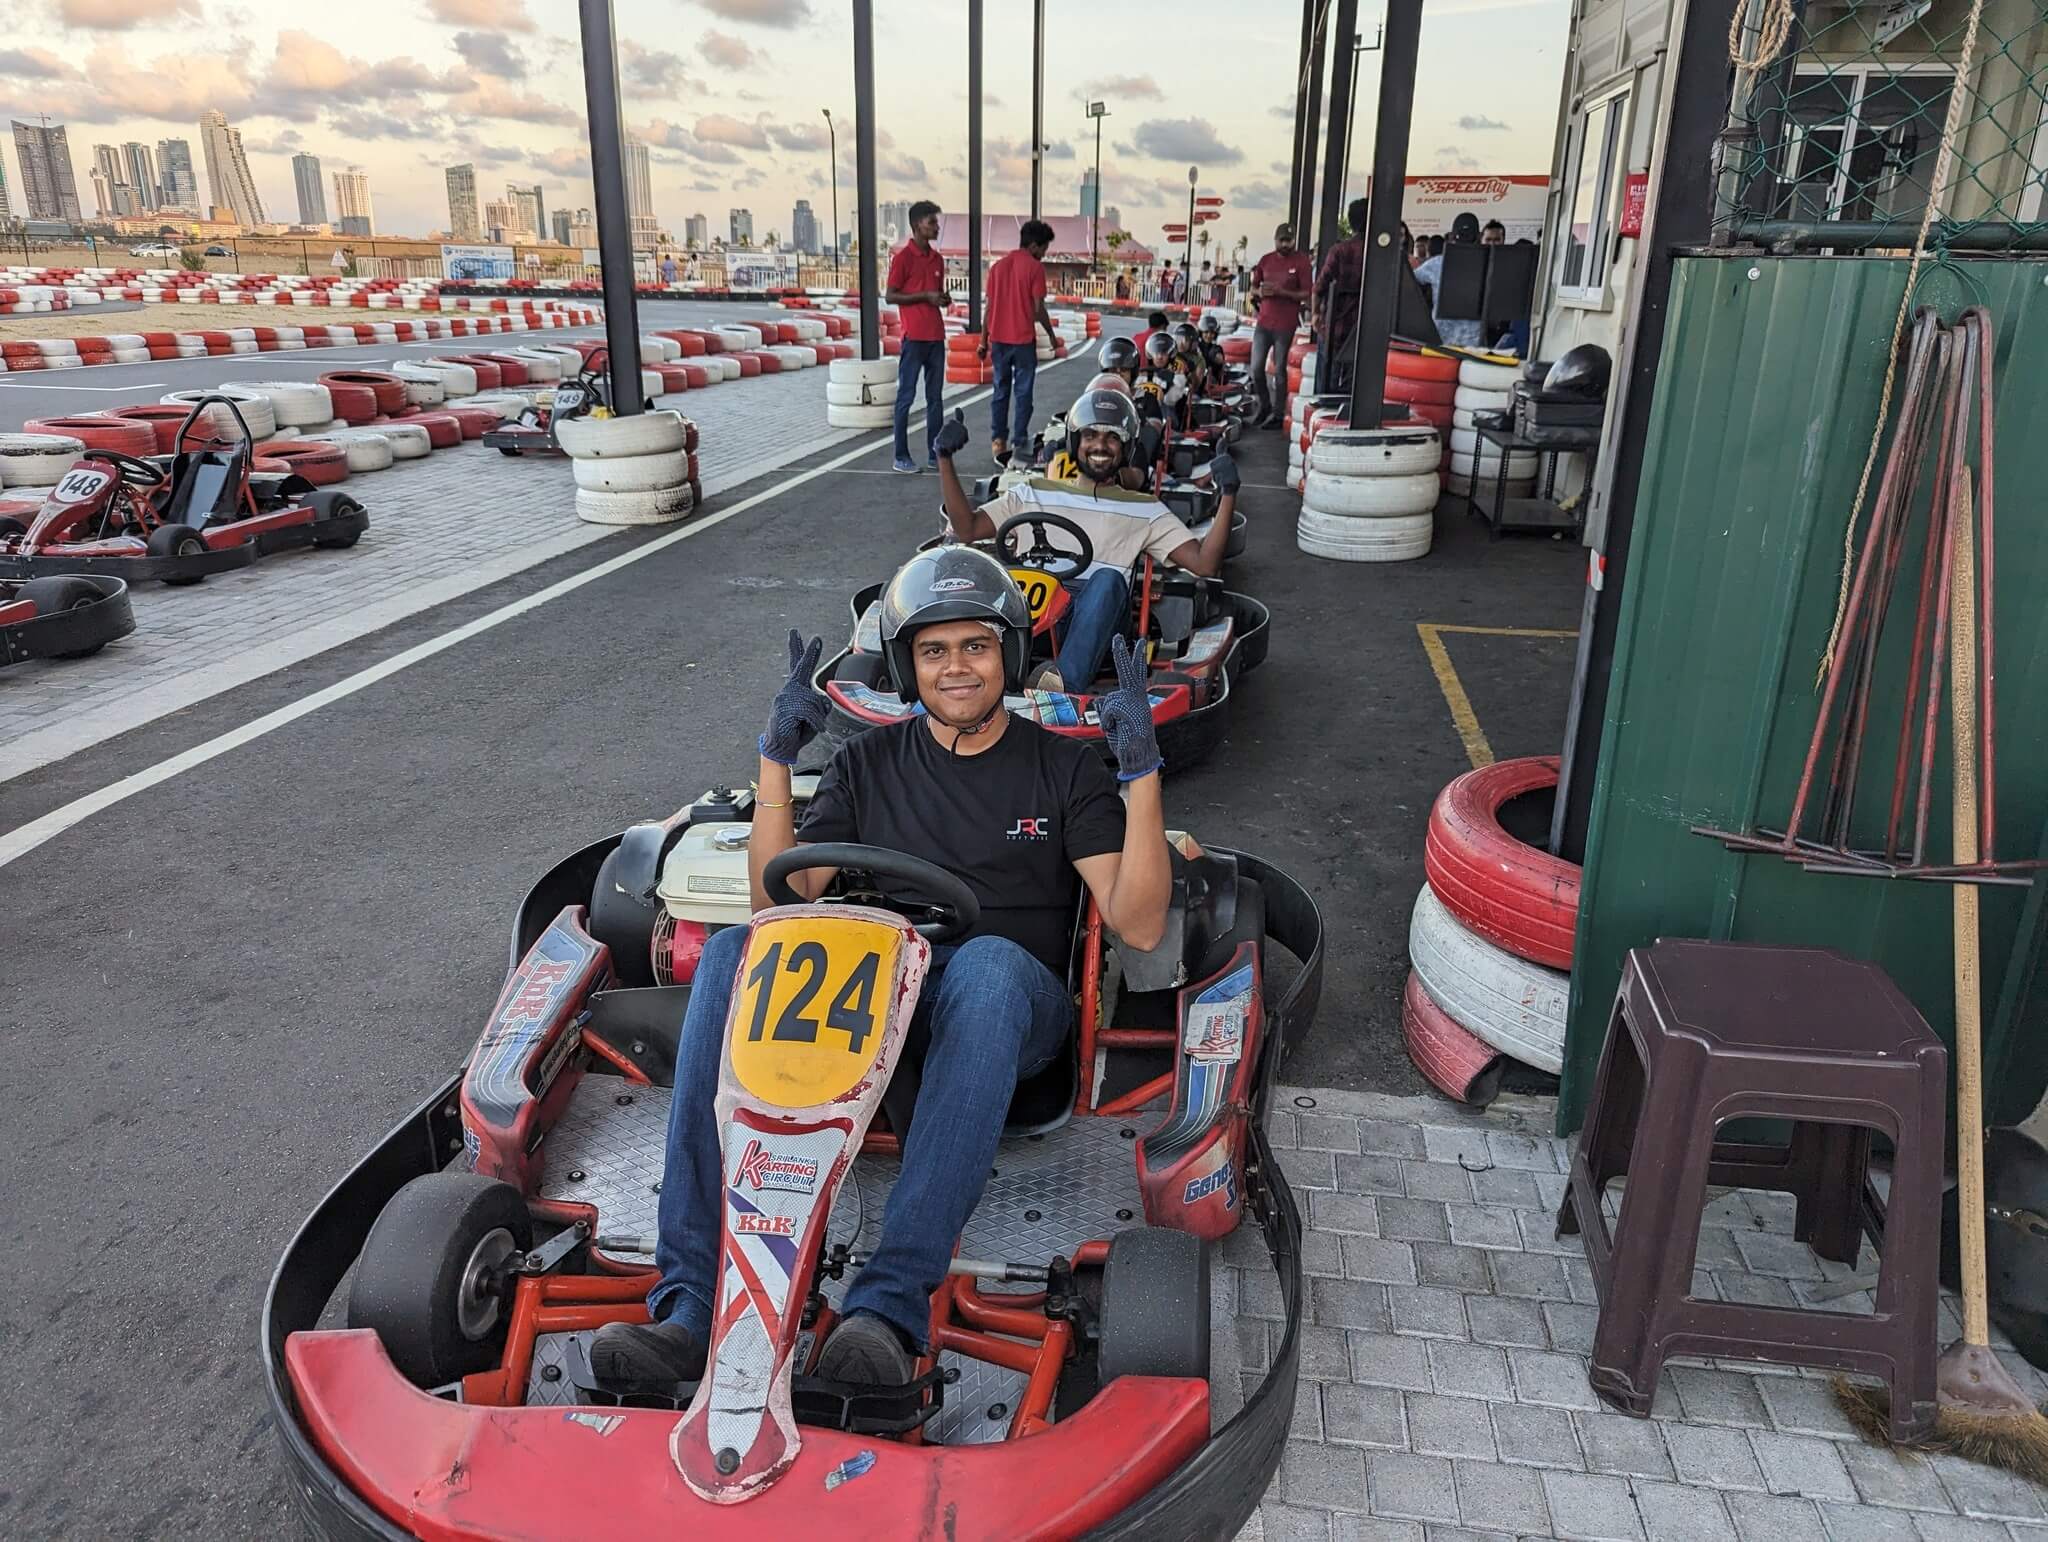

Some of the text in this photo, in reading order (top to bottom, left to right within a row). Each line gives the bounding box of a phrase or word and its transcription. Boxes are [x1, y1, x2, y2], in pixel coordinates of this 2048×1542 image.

[60, 473, 103, 497] 148
[1006, 817, 1049, 836] JRC
[501, 961, 575, 1022] KnK
[747, 941, 881, 1055] 124
[763, 1173, 813, 1187] CIRCUIT
[737, 1214, 793, 1234] KnK
